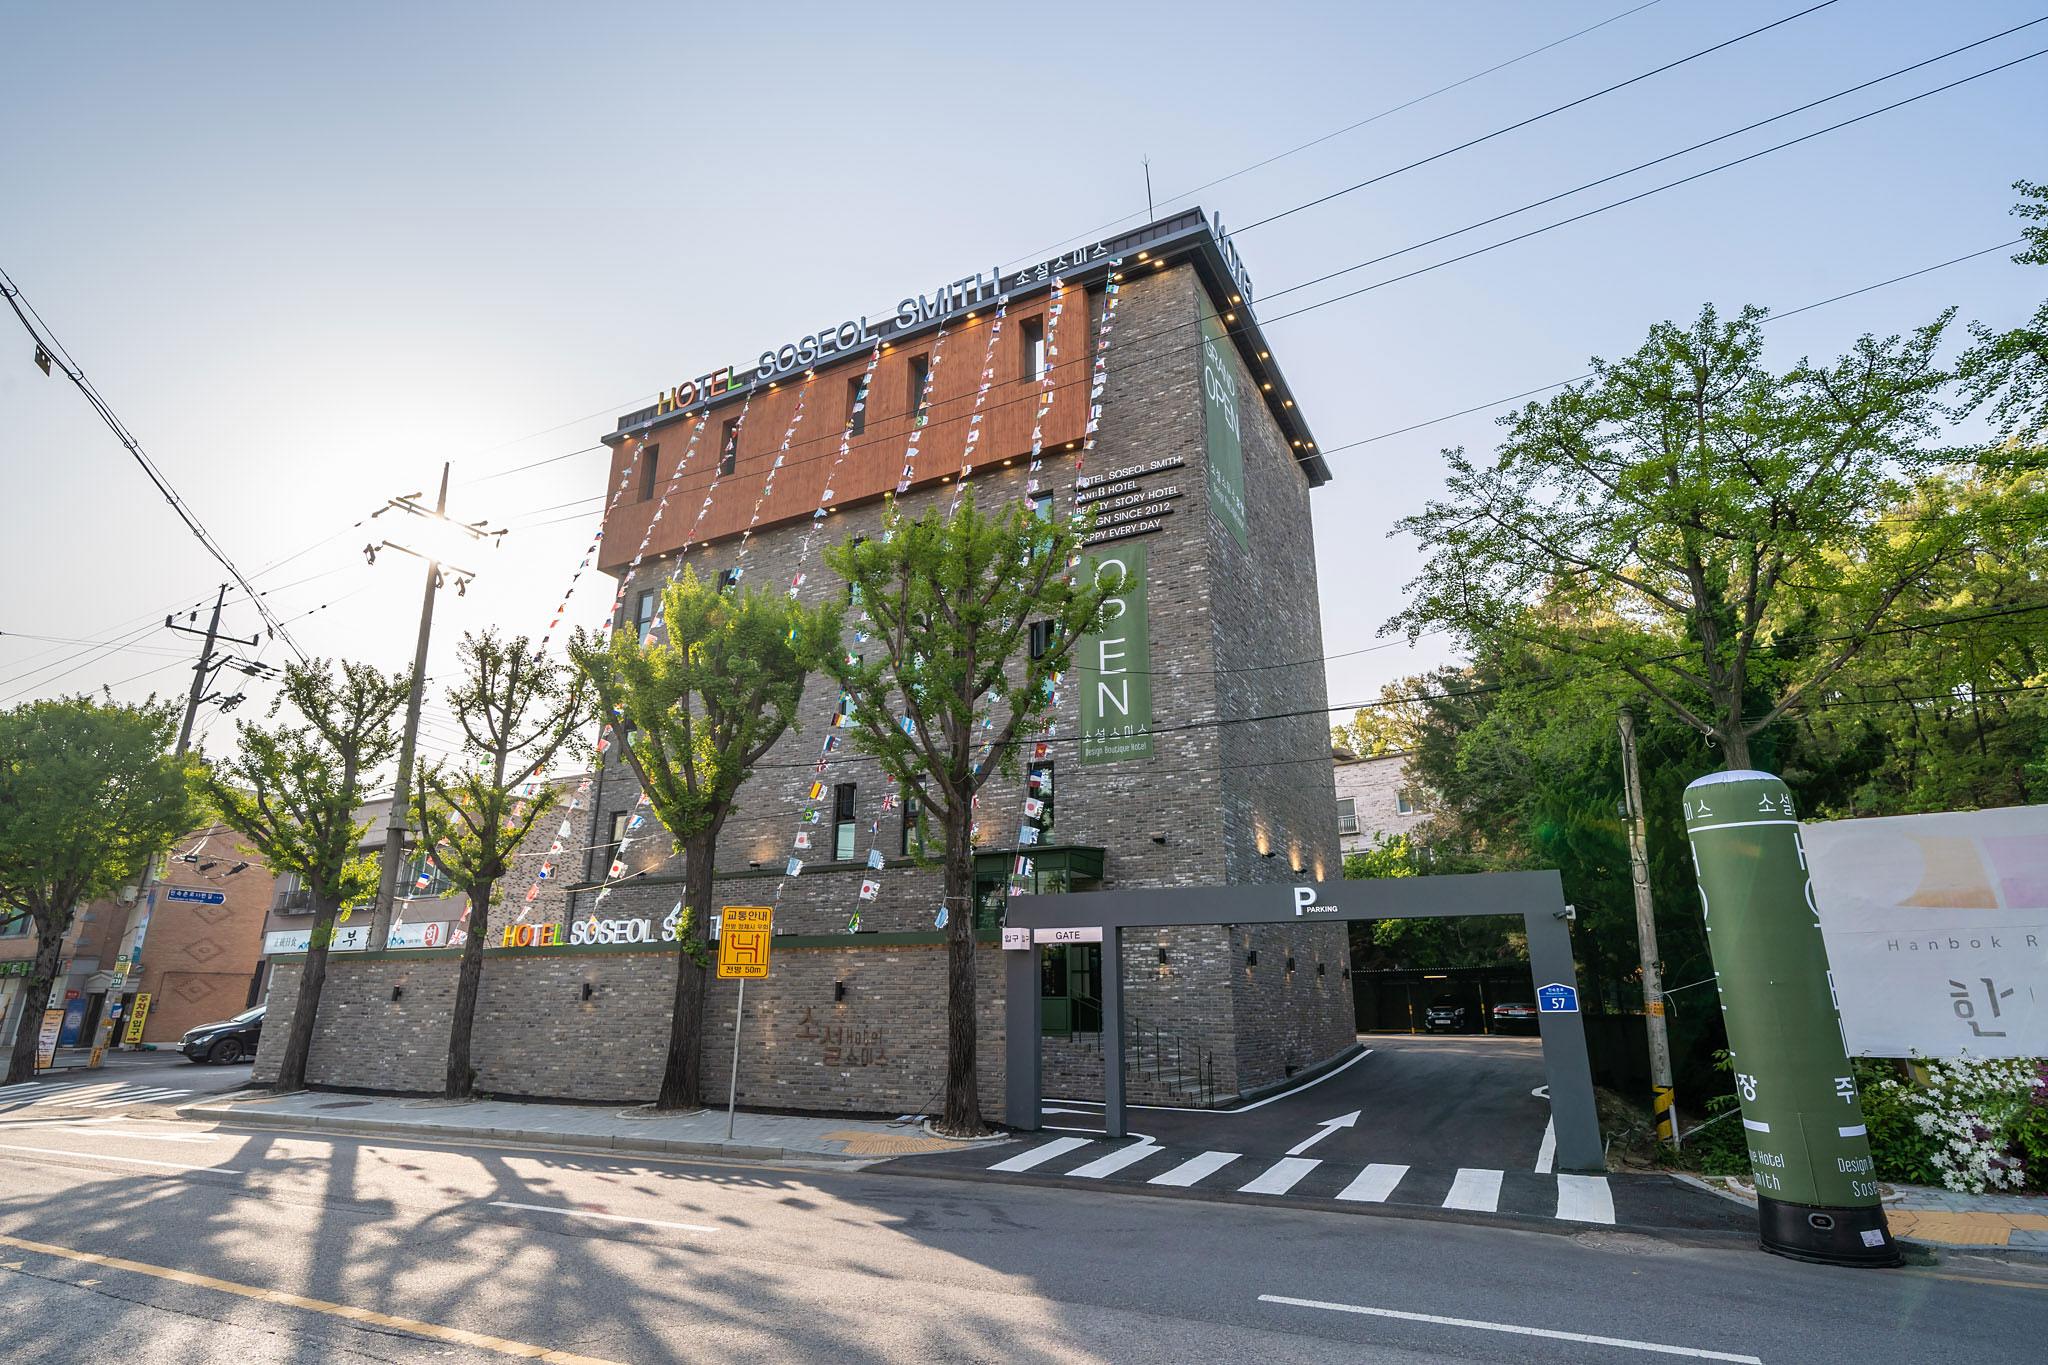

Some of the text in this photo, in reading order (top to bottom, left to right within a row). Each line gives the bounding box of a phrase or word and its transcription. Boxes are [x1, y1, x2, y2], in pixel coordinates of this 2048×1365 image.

[1015, 242, 1108, 286] 소설스미스
[657, 266, 1000, 416] HOTEL SOSEOL SMITH
[1204, 335, 1236, 397] GRAND
[1205, 365, 1240, 442] OPEN
[1109, 464, 1148, 481] SOSEOL
[1150, 456, 1183, 470] SMITH
[1108, 480, 1138, 494] HOTEL
[1115, 493, 1145, 507] STORY
[1148, 485, 1178, 499] HOTEL
[1114, 508, 1142, 522] SINCE
[1145, 502, 1170, 515] 2012
[1109, 524, 1137, 538] EVERY
[1140, 519, 1161, 531] DAY
[1758, 793, 1795, 816] 소설
[1294, 887, 1338, 916] P PARKING
[727, 910, 768, 921] 교통안내
[502, 923, 567, 947] HOTEL
[570, 918, 658, 946] SOSEOL
[1004, 934, 1019, 943] 입구
[1055, 931, 1081, 940] GATE
[1887, 935, 2002, 951] Hanbok
[726, 966, 761, 974] 전방 50m
[1551, 998, 1565, 1009] 57
[1758, 1149, 1785, 1168] Hotel
[1837, 1156, 1869, 1176] Design
[1753, 1168, 1781, 1191] mith
